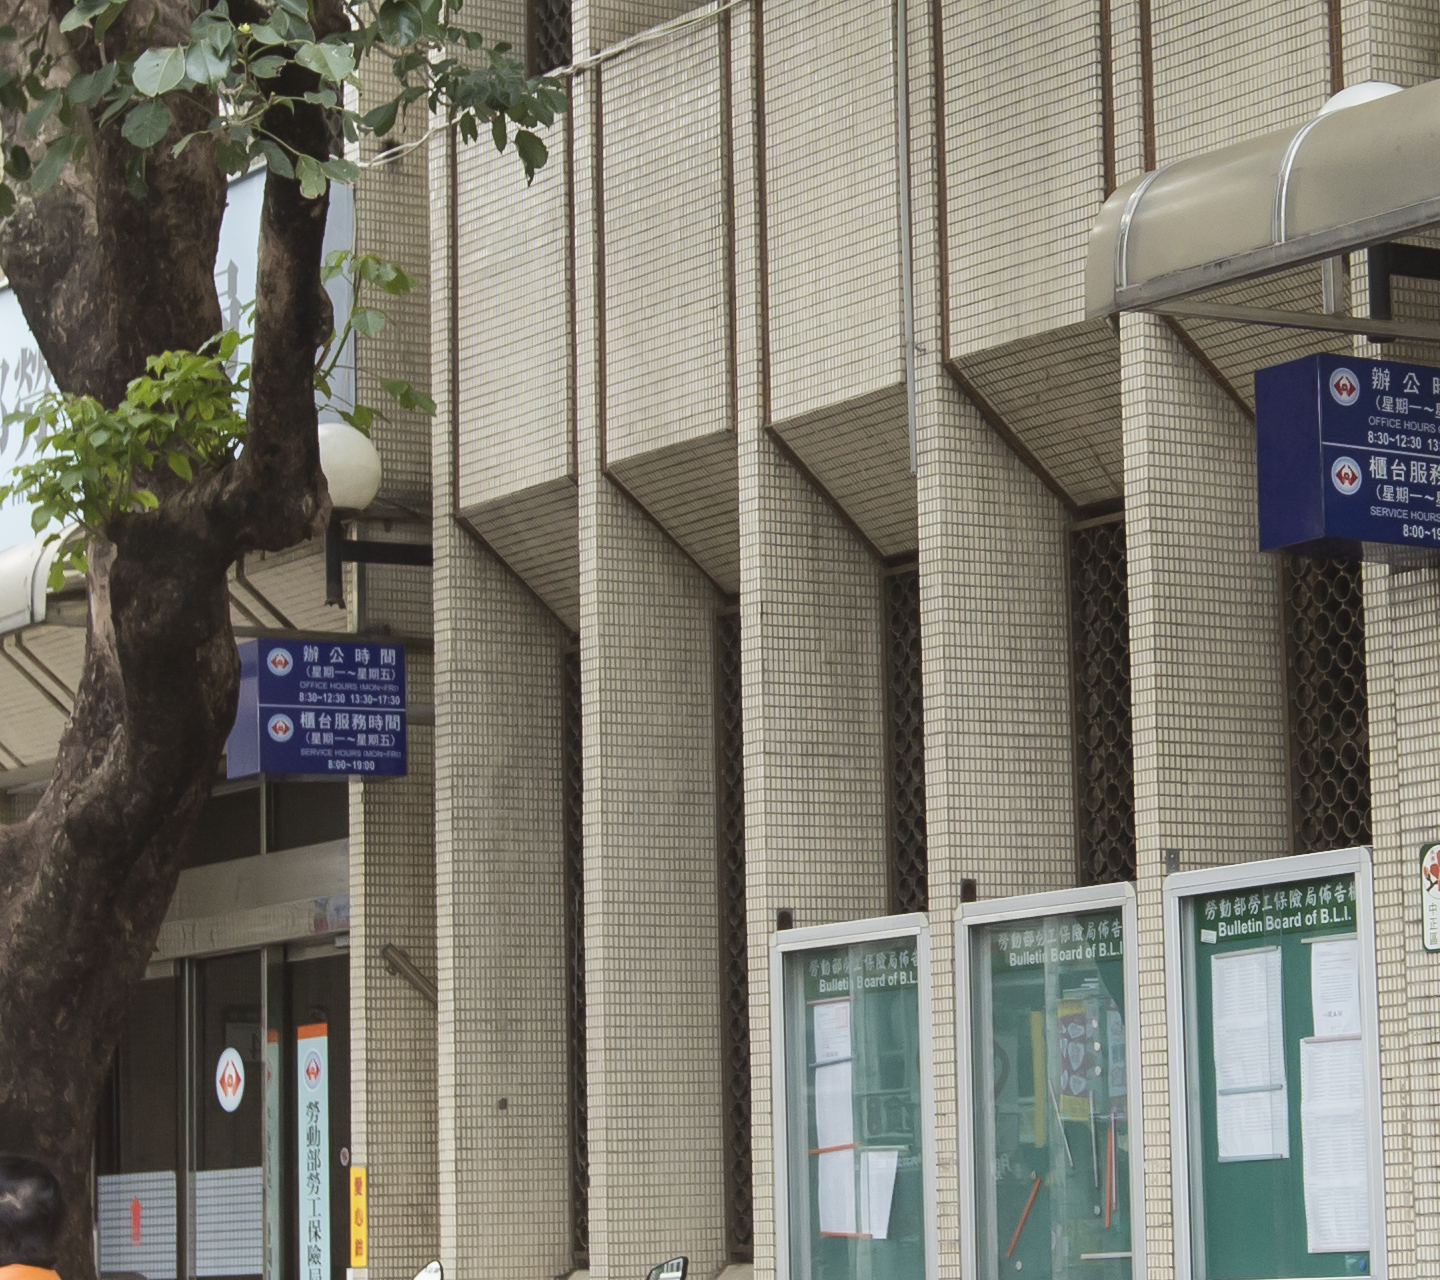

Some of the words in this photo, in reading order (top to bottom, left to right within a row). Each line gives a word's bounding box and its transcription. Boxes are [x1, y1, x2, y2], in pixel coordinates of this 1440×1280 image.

[1368, 416, 1402, 429] OFFICE
[1404, 419, 1436, 434] HOURS
[1367, 431, 1422, 449] 8:30~12:30
[1370, 505, 1409, 519] SERVICE
[303, 645, 396, 665] 辦公時間
[299, 681, 328, 690] OFFICE
[330, 682, 358, 691] HOURS
[299, 692, 346, 704] 8:30~12:30
[350, 693, 401, 705] 13:30~17:30
[300, 711, 401, 732] 櫃台服務時間
[300, 748, 333, 757] SERVICE
[328, 759, 375, 771] 8:00~19:00
[1218, 919, 1263, 937] Bulletin
[1265, 912, 1302, 931] Board
[1305, 909, 1317, 926] of
[1320, 906, 1352, 924] B.L.I.
[1428, 902, 1438, 946] 中正區
[1010, 949, 1048, 967] Bulletin
[1051, 945, 1083, 962] Board
[1085, 943, 1097, 959] of
[819, 977, 855, 993] Bulletin
[857, 973, 885, 989] Board
[888, 971, 898, 986] of
